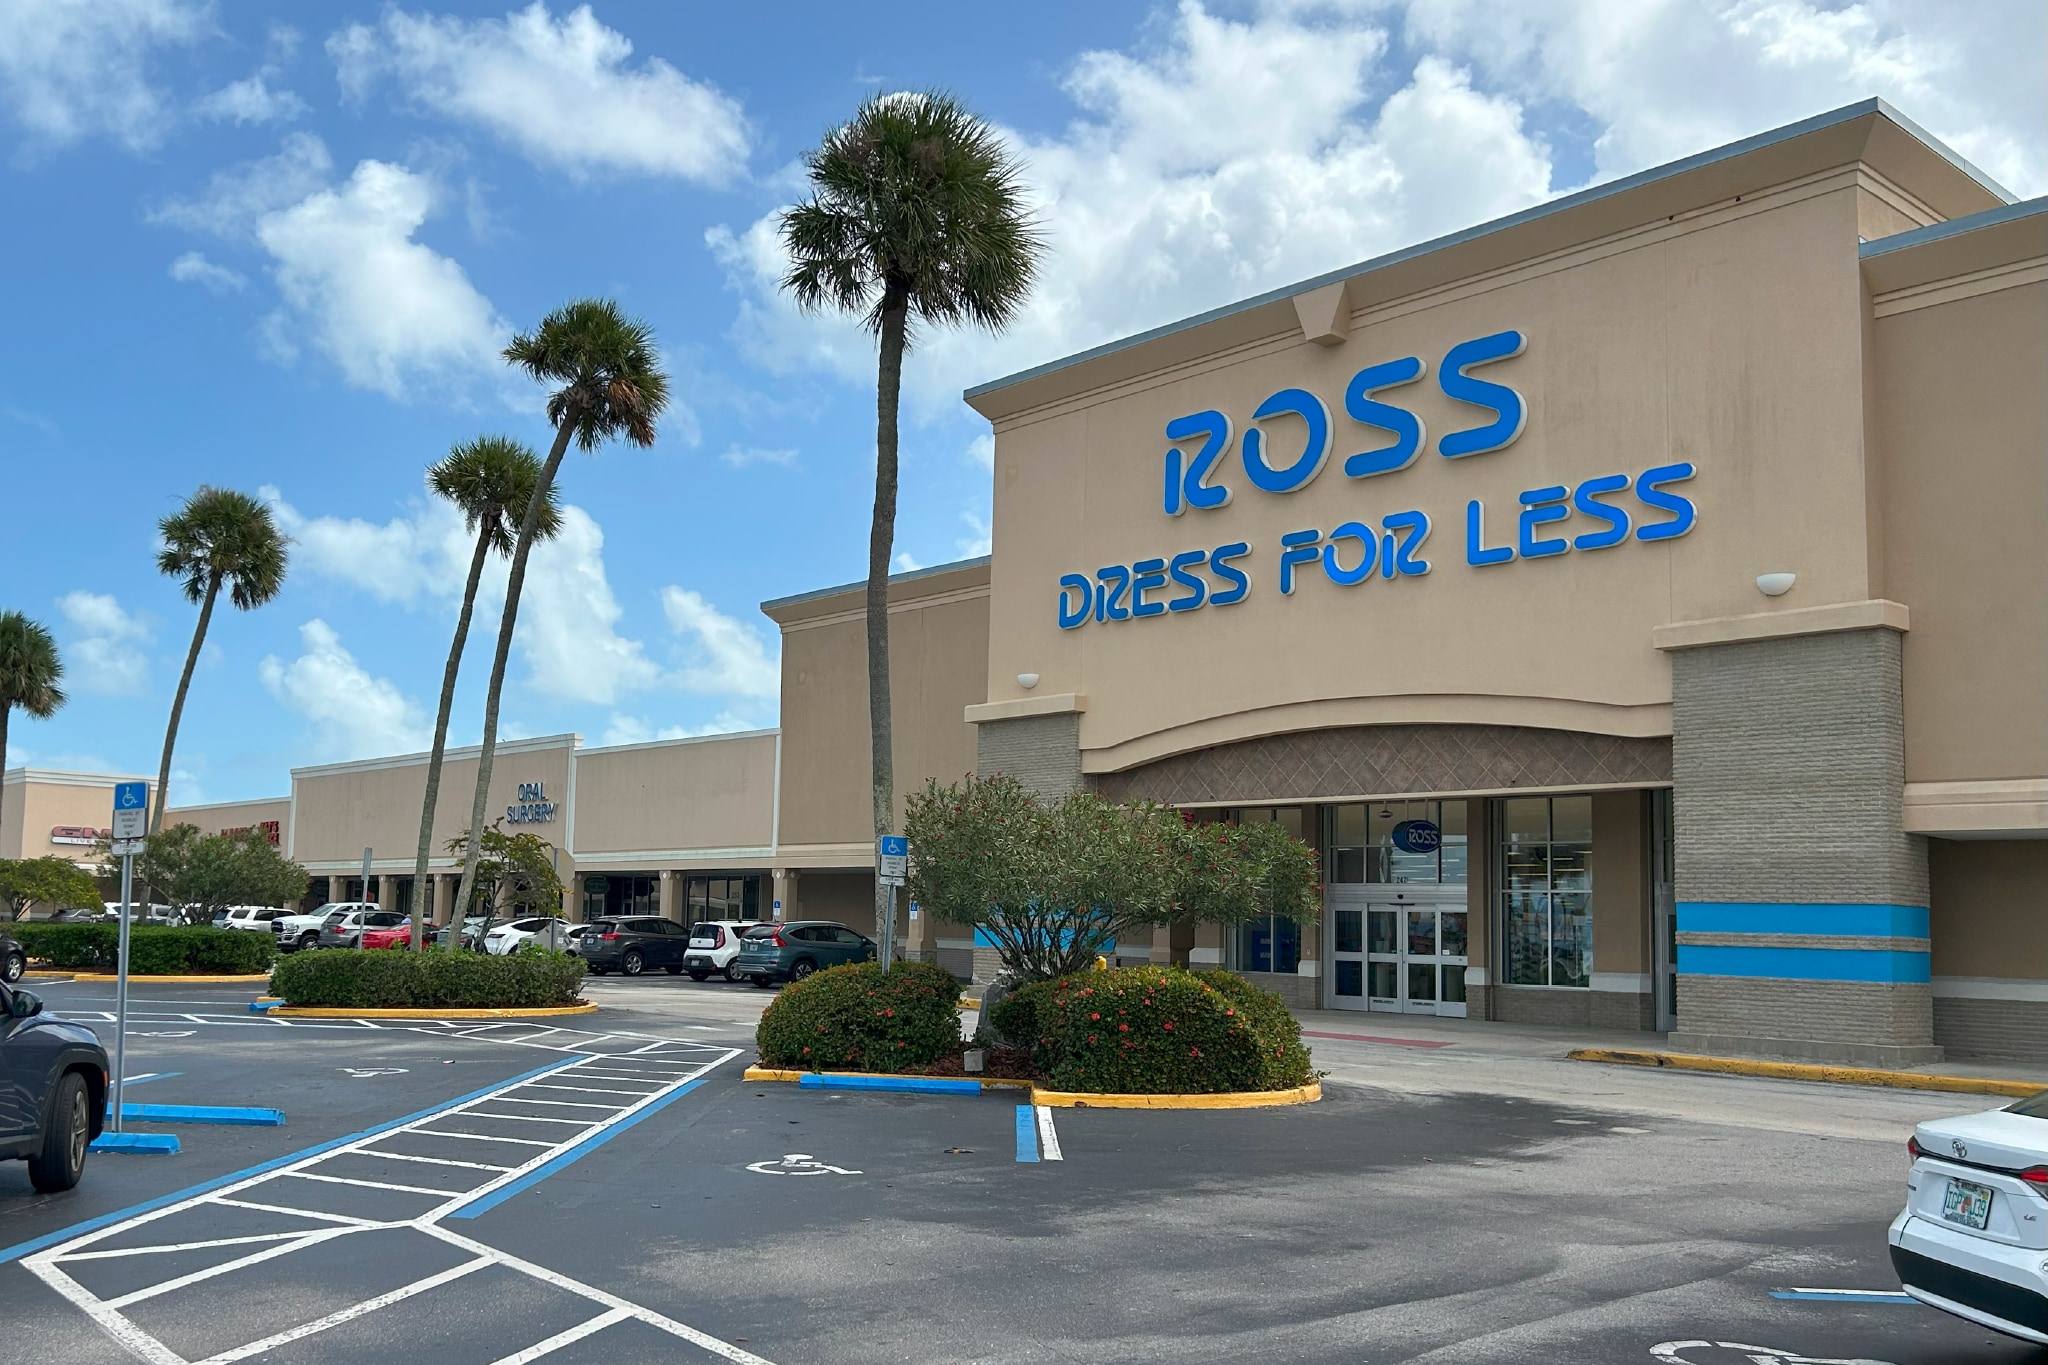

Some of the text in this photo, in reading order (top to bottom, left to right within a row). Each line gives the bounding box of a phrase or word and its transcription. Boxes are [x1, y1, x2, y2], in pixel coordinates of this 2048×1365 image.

[1164, 331, 1524, 515] ROSS
[1058, 463, 1698, 629] DRESS FOR LESS
[518, 782, 546, 801] ORAL
[507, 803, 556, 824] SURGERY
[52, 826, 112, 839] GN
[1409, 829, 1438, 844] ROSS
